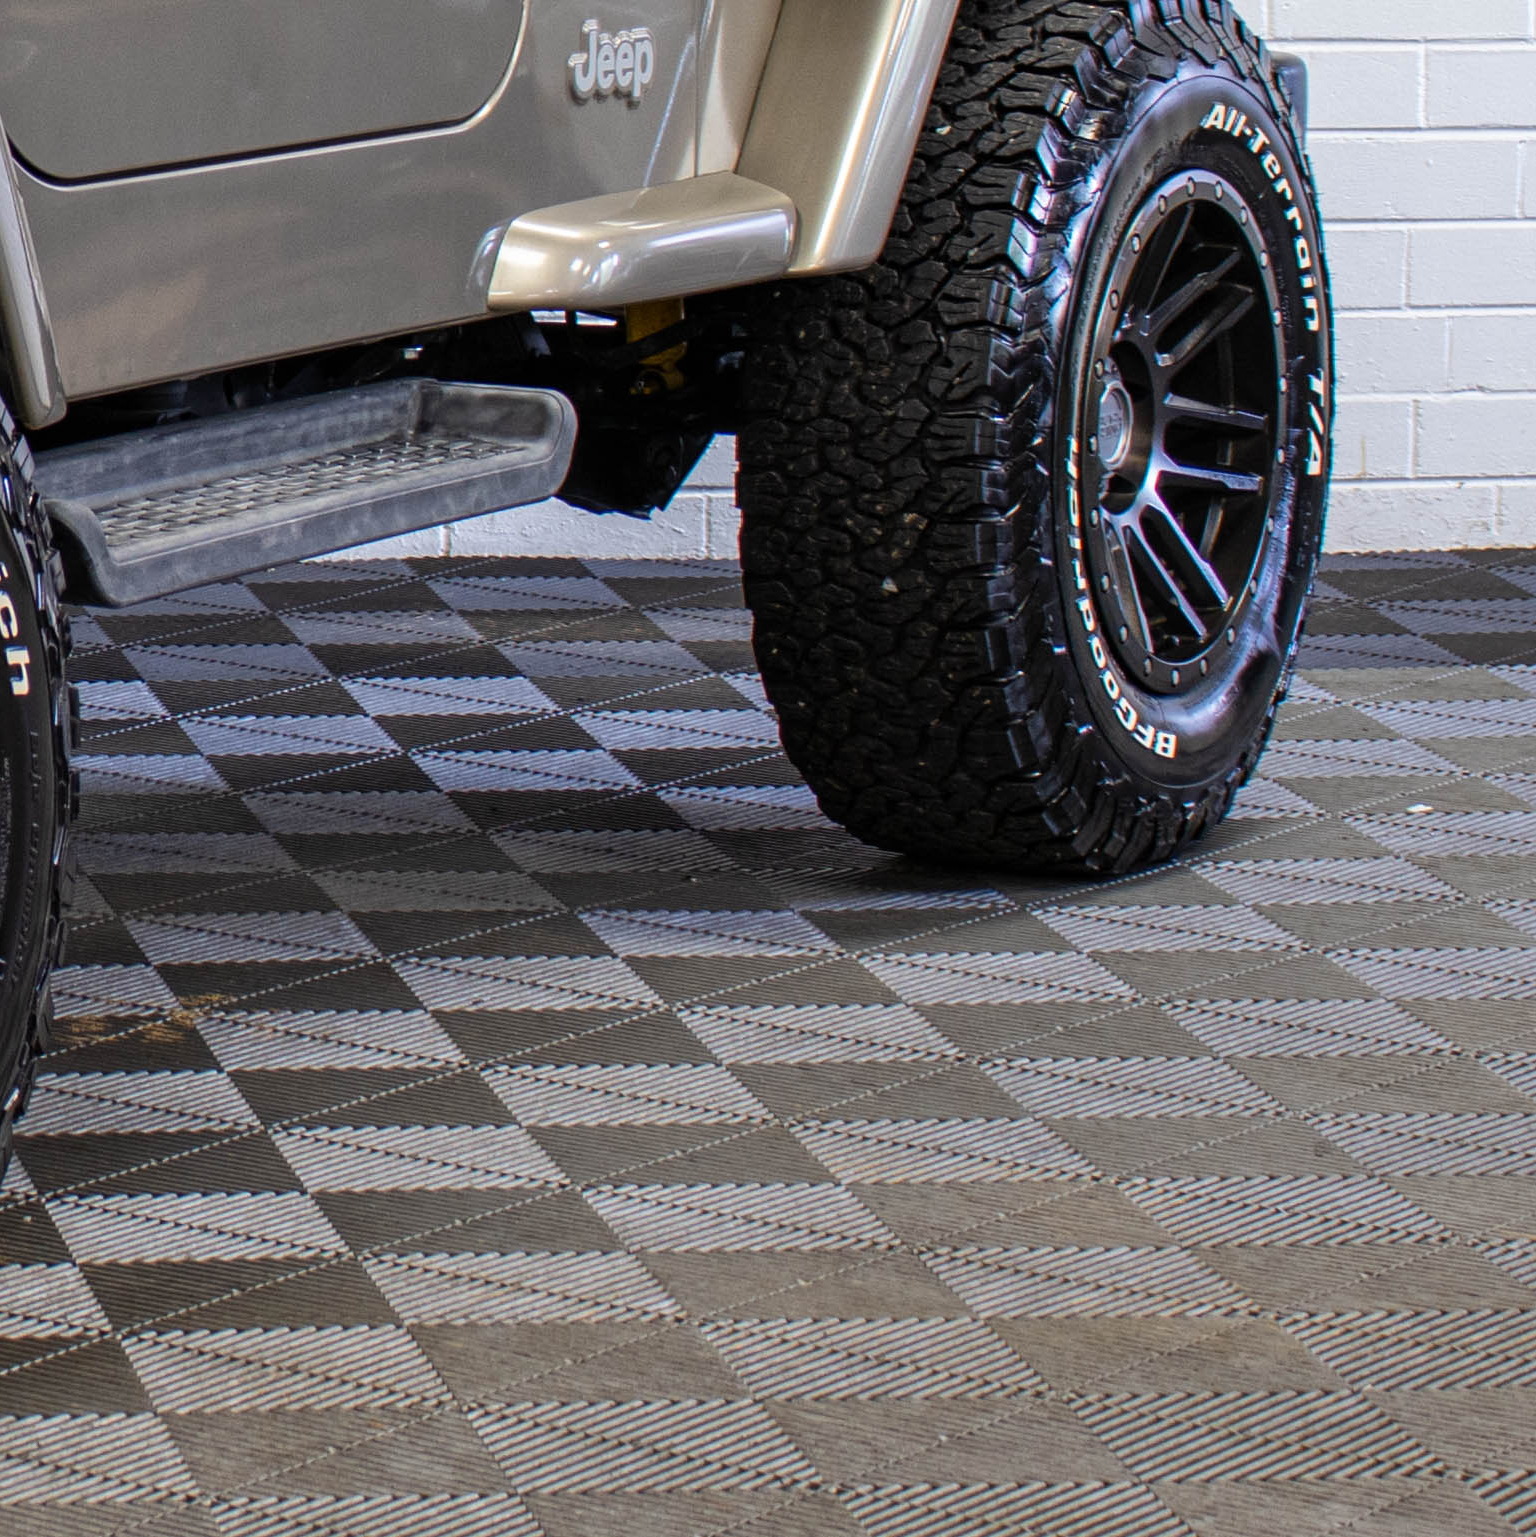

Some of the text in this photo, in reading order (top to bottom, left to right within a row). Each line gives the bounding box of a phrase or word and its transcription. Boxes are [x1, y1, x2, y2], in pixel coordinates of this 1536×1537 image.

[569, 19, 654, 104] Jeep
[1202, 101, 1326, 477] All-Terrain T/A
[1066, 435, 1178, 760] BFGoodrich
